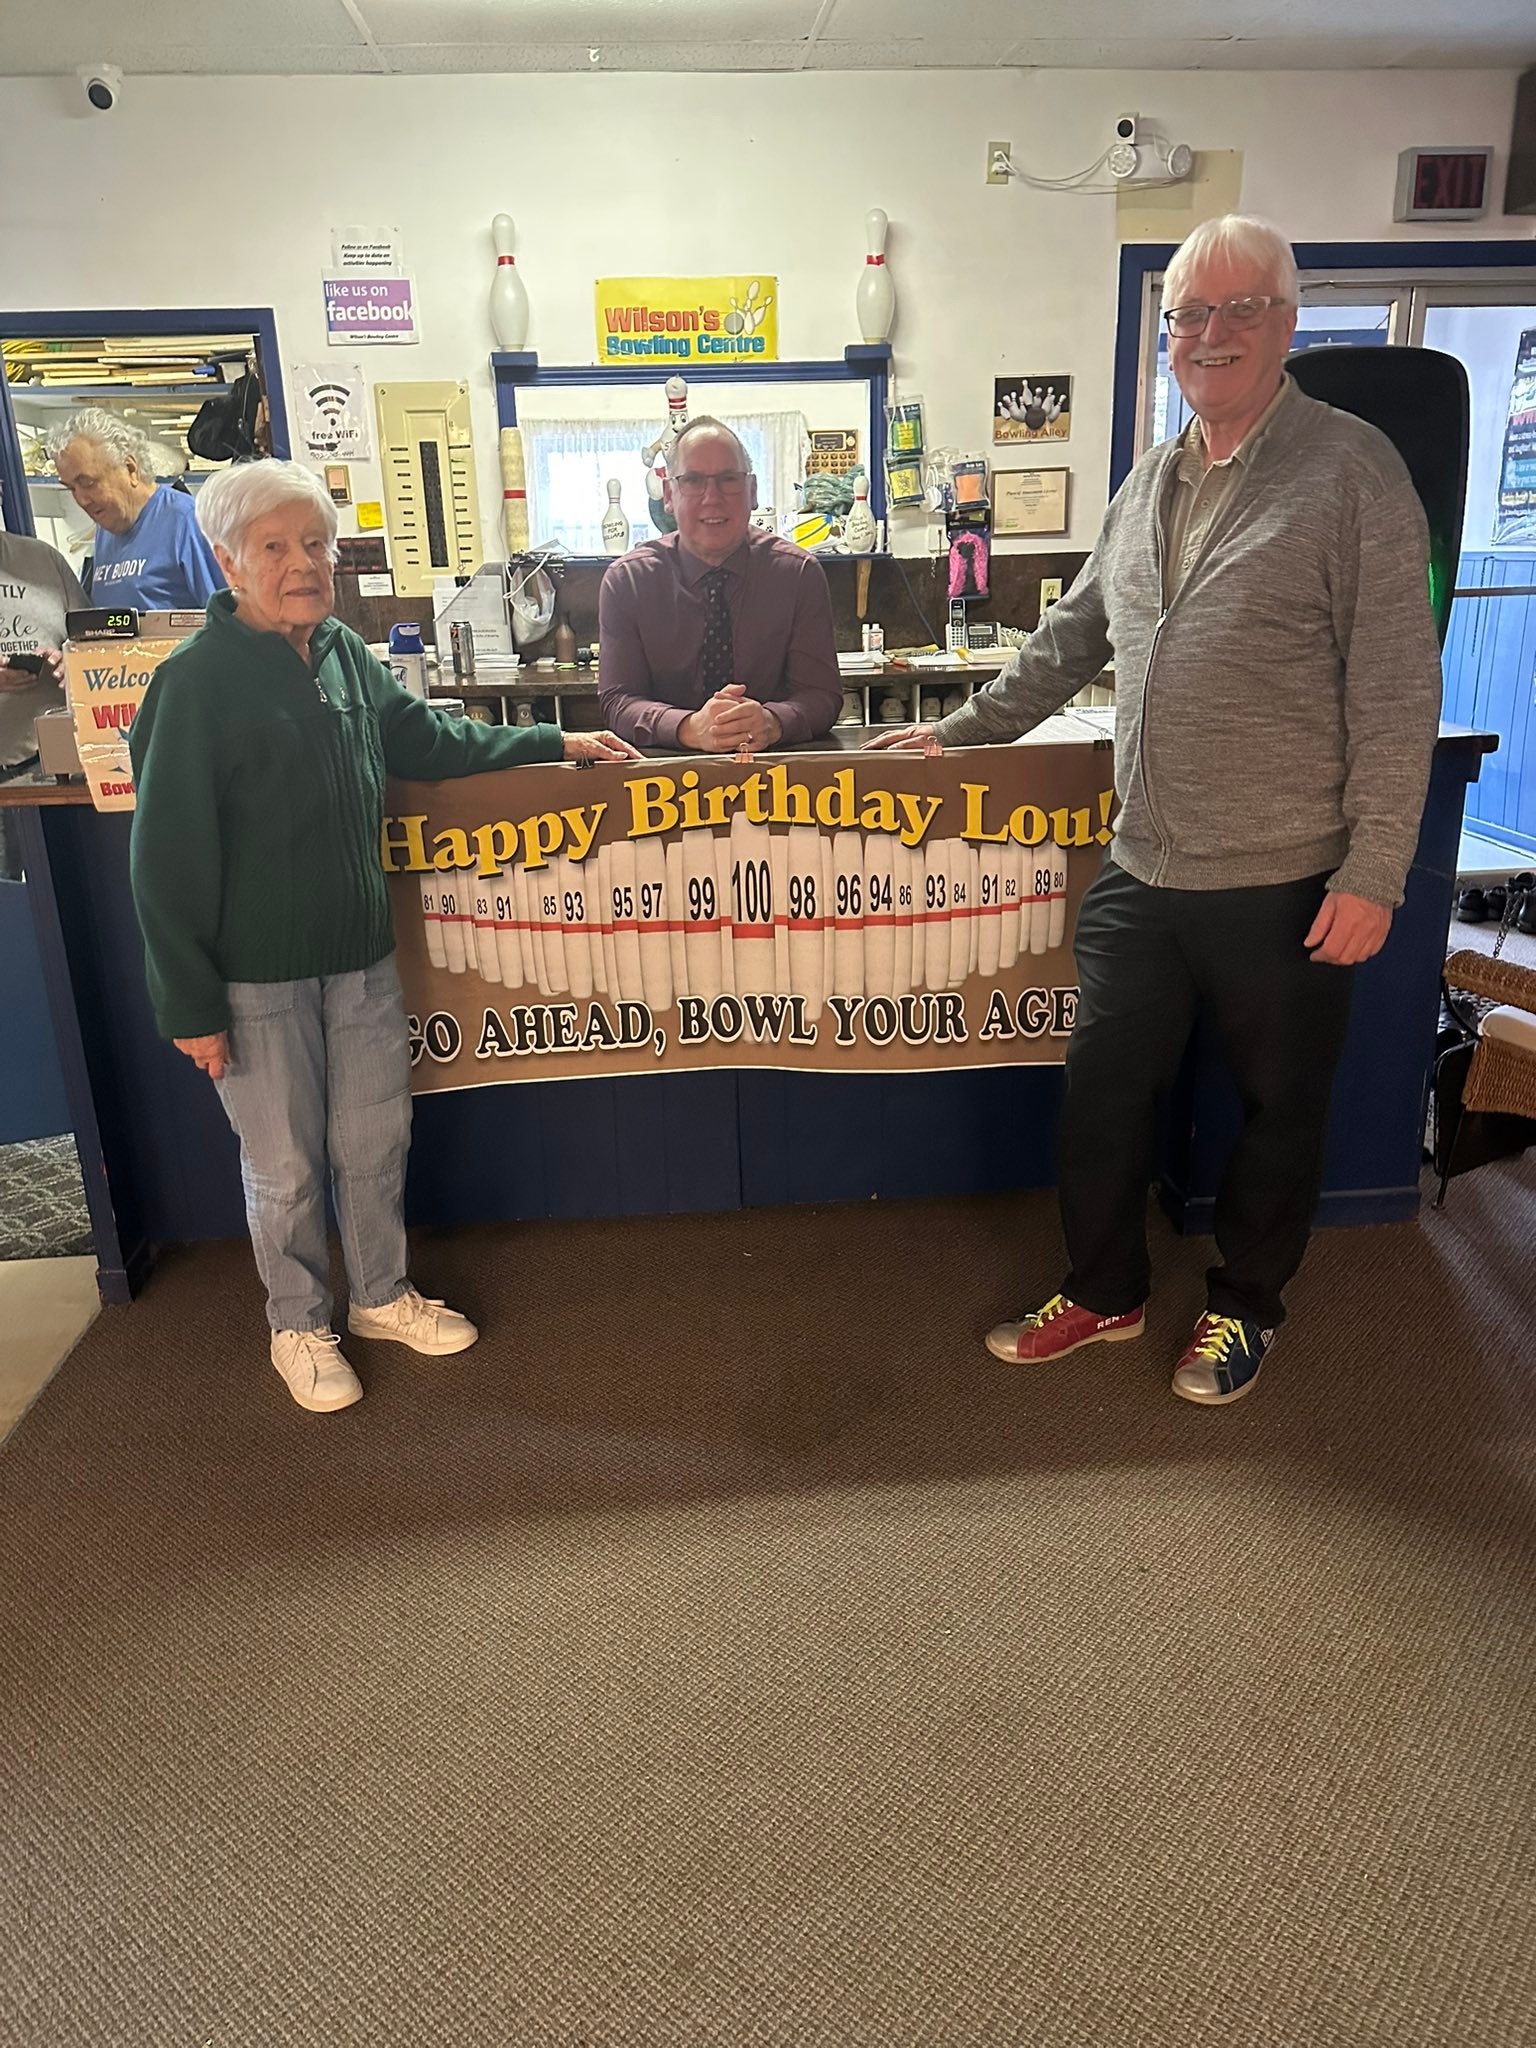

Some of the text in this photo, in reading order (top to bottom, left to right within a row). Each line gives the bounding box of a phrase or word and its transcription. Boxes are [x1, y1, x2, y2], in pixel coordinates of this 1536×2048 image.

[1414, 156, 1484, 208] EXIT
[325, 283, 388, 297] like us on
[327, 300, 414, 321] facebook
[605, 306, 720, 333] Wilson's
[606, 334, 765, 357] Bowling Centre
[312, 430, 358, 439] free WiFi
[995, 427, 1067, 439] Bowling Alley
[94, 559, 146, 581] HEY BUDDY
[107, 615, 130, 627] 2.50
[85, 628, 115, 637] SHARP
[83, 665, 155, 692] Welco
[382, 764, 1114, 878] Happy Birthday Lou!
[424, 859, 1065, 923] 81 90 83 91 85 93 95 97 99 100 98 96 94 86 93 84 91 82 89 80
[475, 1000, 667, 1060] AHEAD,
[678, 994, 819, 1046] BOWL
[828, 992, 969, 1045] YOUR
[979, 985, 1080, 1040] AGE
[1096, 1315, 1125, 1330] REN
